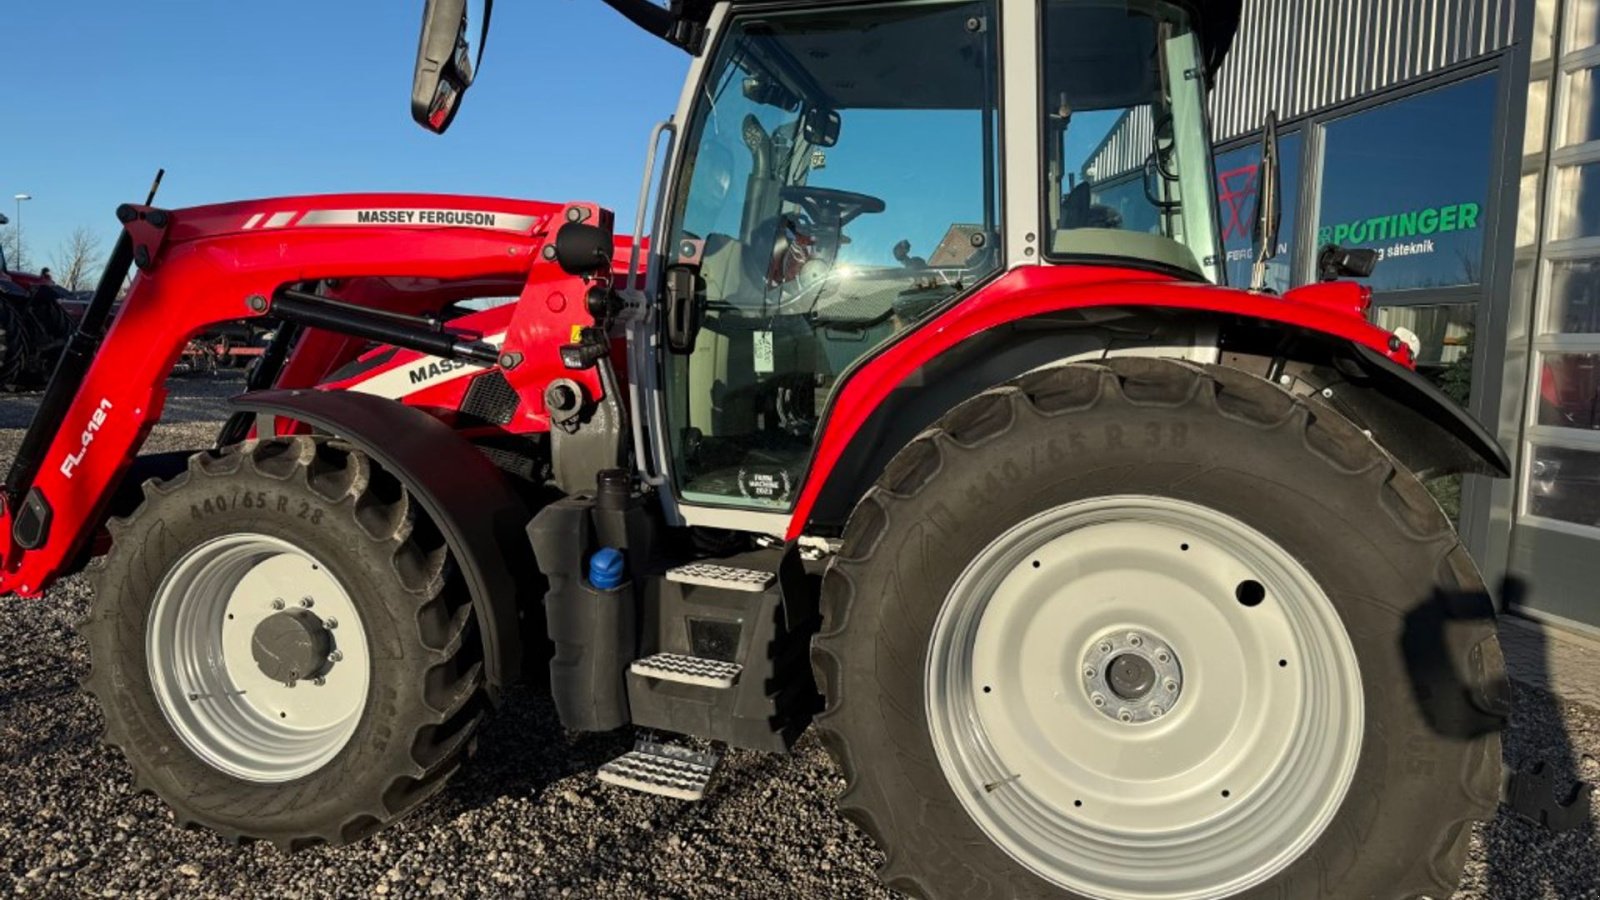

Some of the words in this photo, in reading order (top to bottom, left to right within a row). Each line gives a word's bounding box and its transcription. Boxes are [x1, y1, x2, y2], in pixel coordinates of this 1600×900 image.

[358, 211, 414, 223] MASSEY
[419, 211, 495, 226] FERGUSON
[1104, 423, 1126, 450] R
[1144, 420, 1189, 449] 38
[190, 491, 267, 520] 440/65
[276, 495, 289, 513] R
[298, 502, 324, 525] 28
